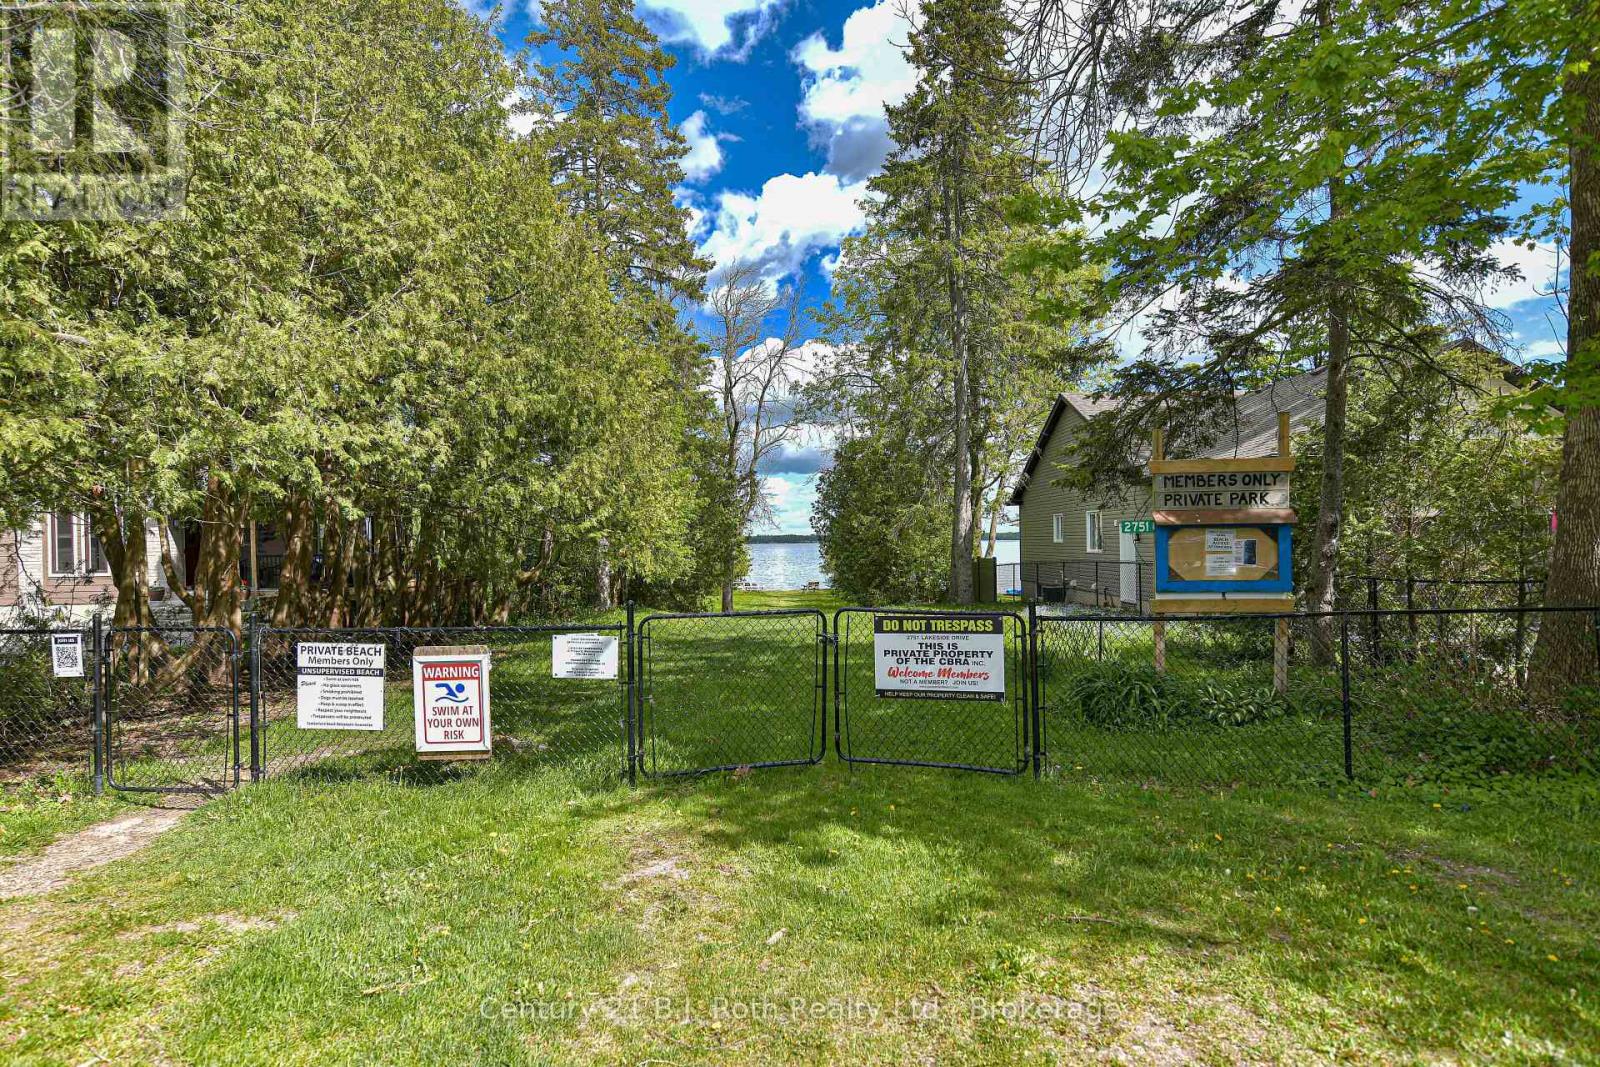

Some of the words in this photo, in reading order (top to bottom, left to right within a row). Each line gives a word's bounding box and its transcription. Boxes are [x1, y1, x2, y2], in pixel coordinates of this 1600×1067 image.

[1163, 474, 1237, 488] MEMBERS
[1241, 473, 1281, 486] ONLY
[1164, 493, 1223, 506] PRIVATE
[1229, 492, 1271, 505] PARK
[1124, 521, 1149, 532] 2751
[882, 619, 900, 631] DO
[902, 619, 926, 631] NOT
[929, 619, 994, 632] TRESPASS
[300, 645, 344, 656] PRIVATE
[346, 646, 382, 656] BEACH
[917, 642, 944, 650] THIS
[947, 642, 959, 650] IS
[883, 649, 930, 658] PRIVATE
[933, 650, 994, 659] PROPERTY
[308, 656, 350, 665] Members
[352, 657, 374, 667] Only
[938, 658, 970, 666] CBRA
[356, 668, 380, 676] BEACH
[423, 666, 479, 679] WARNING
[887, 666, 934, 678] Welcome
[937, 667, 990, 681] Members
[432, 706, 460, 716] SWIM
[462, 706, 474, 716] AT
[427, 718, 453, 728] YOUR
[455, 718, 479, 728] OWN
[444, 730, 465, 740] RISK
